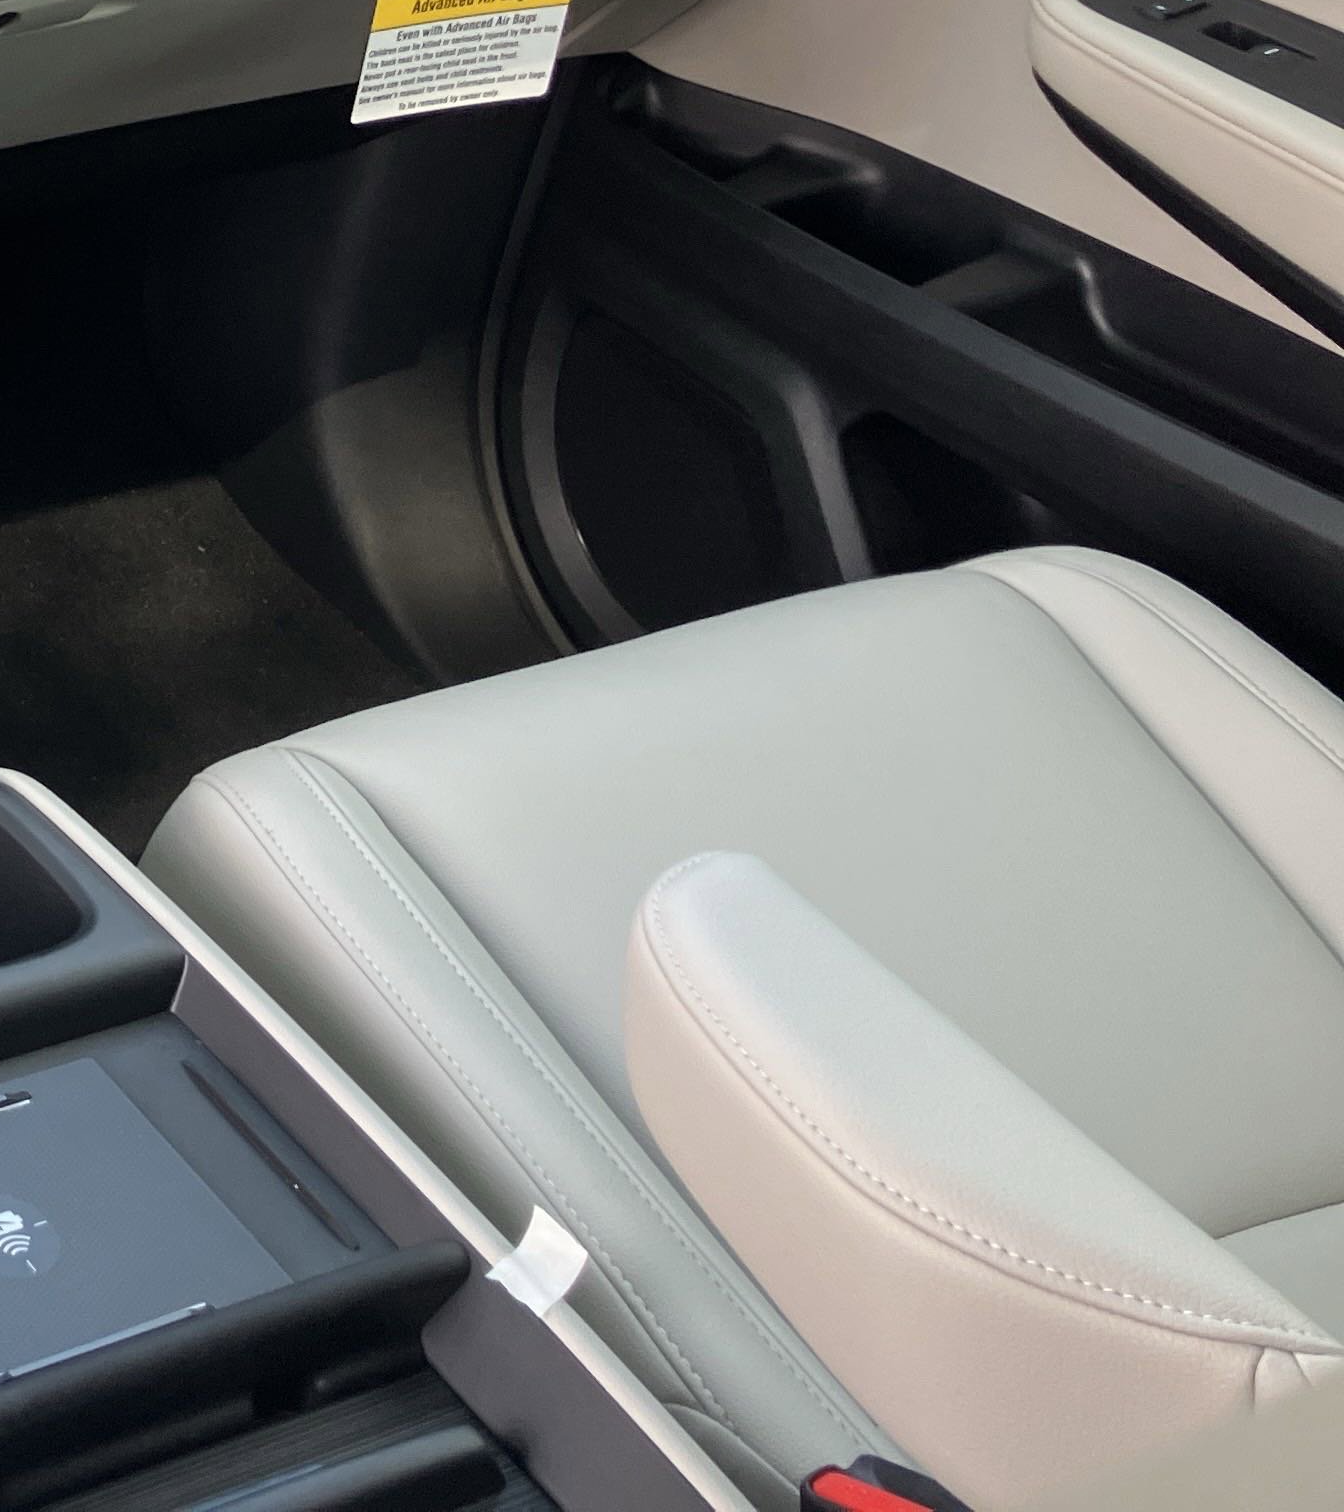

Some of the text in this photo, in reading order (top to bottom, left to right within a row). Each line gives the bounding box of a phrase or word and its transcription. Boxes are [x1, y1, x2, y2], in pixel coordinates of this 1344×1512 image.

[396, 29, 419, 42] Even
[422, 25, 443, 36] with
[445, 17, 493, 34] Advanced
[495, 14, 510, 26] Air
